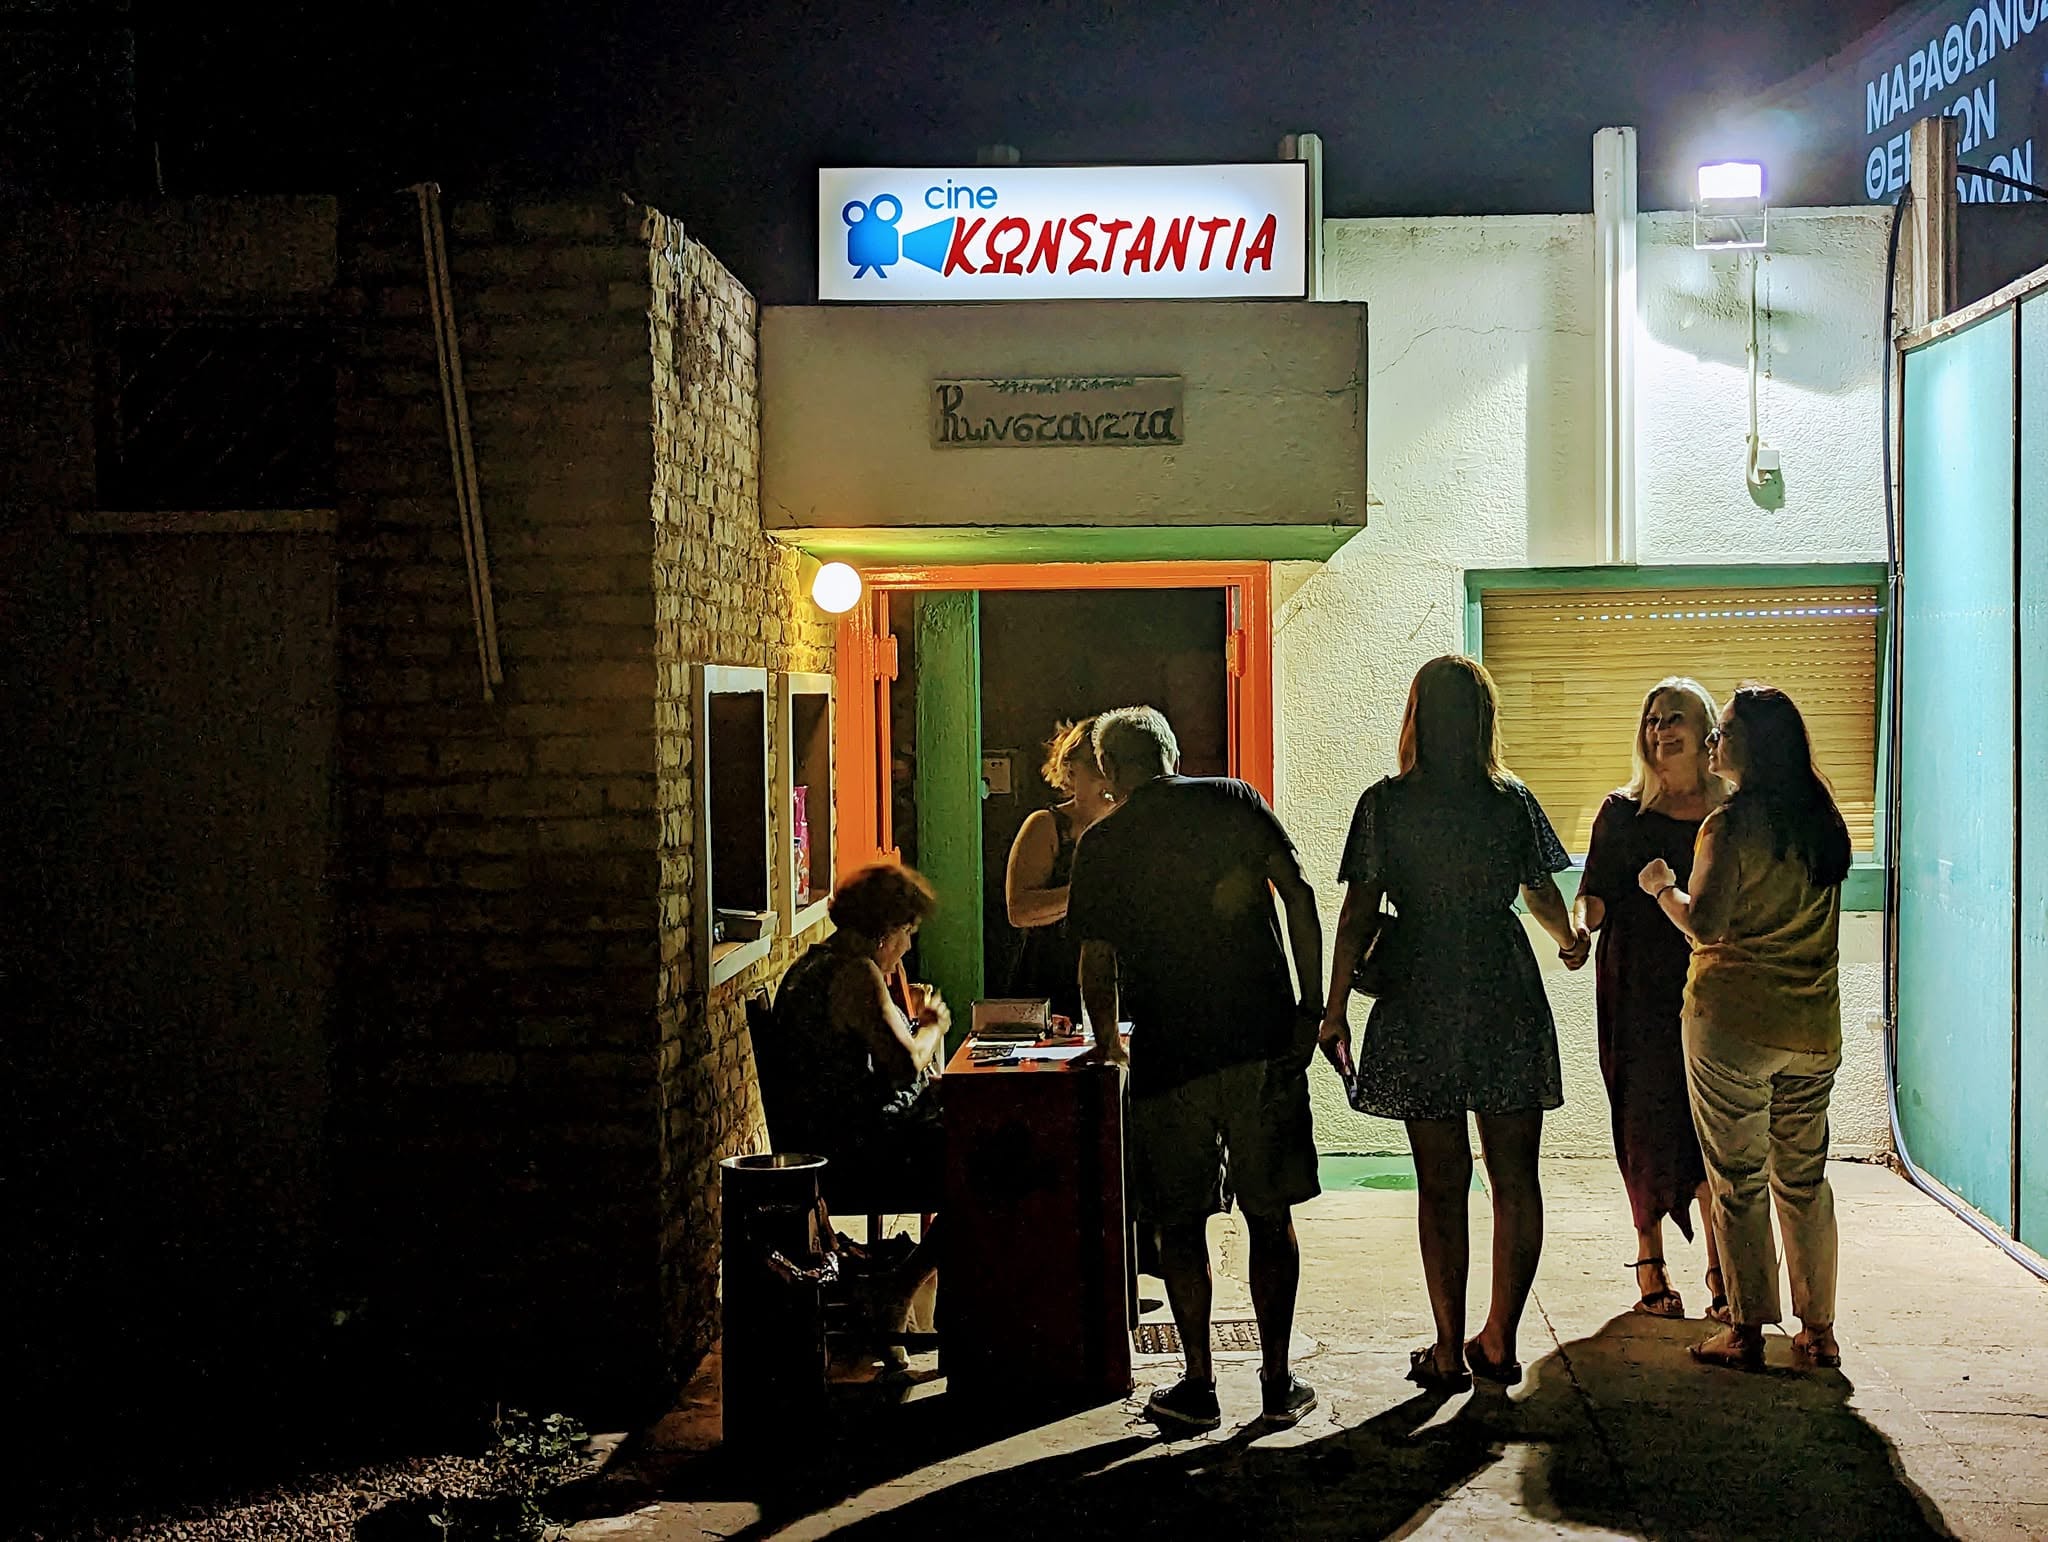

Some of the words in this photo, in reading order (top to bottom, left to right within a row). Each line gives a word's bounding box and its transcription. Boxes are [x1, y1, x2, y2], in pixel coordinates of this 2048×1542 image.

[1866, 0, 2048, 135] ΜΑΡΑΘΩΝΙΟ
[1866, 78, 1996, 200] ΘΕΩΝ
[924, 178, 998, 210] cine
[943, 212, 1278, 278] ΚΩΝΣΤΑΝΤΙΑ
